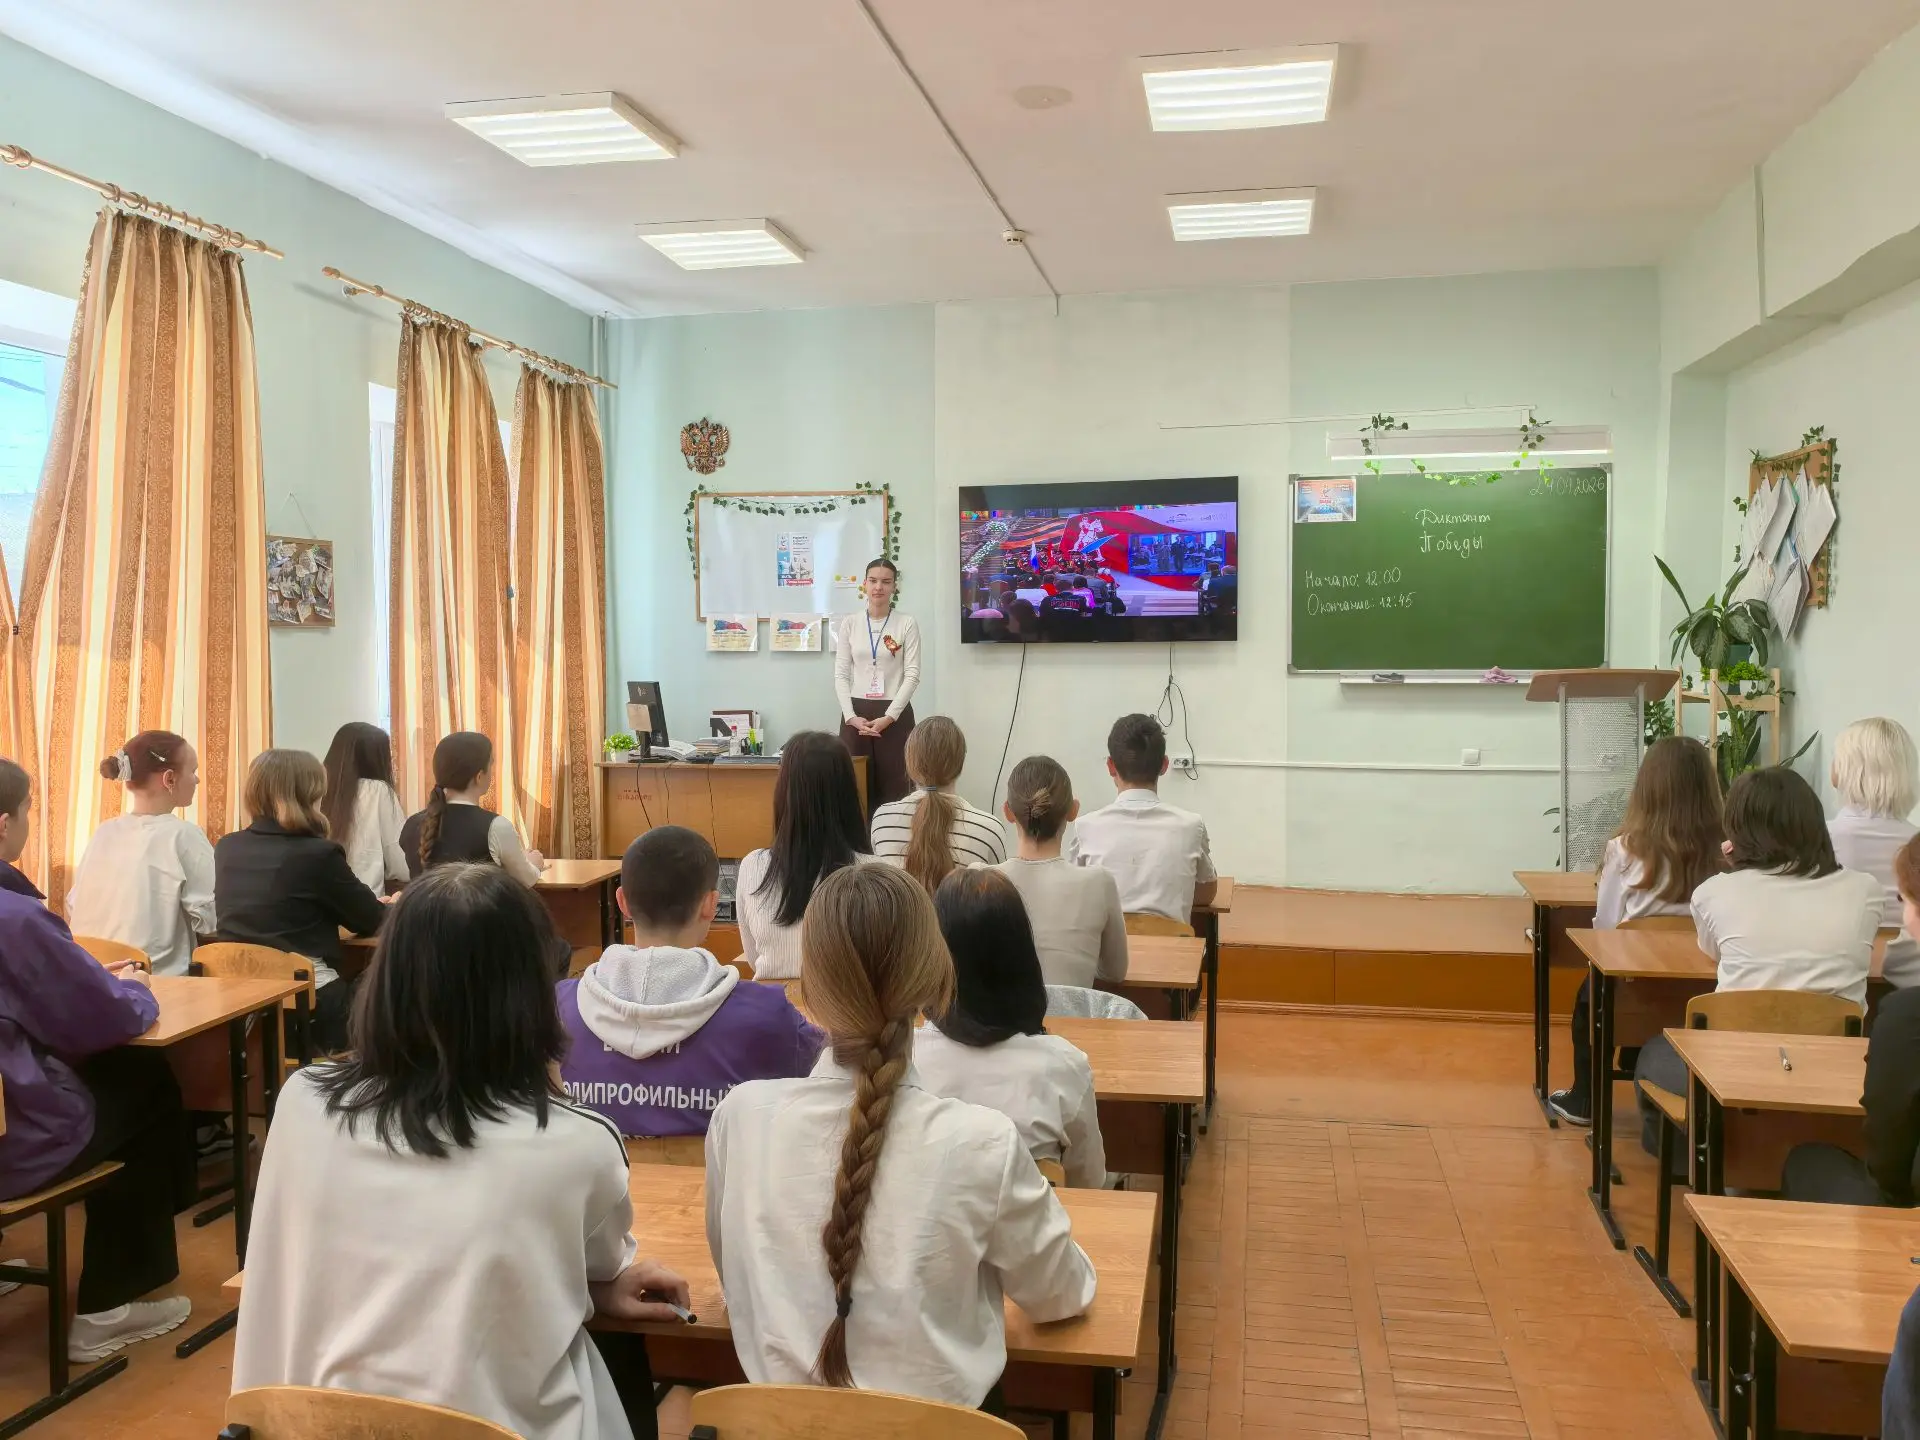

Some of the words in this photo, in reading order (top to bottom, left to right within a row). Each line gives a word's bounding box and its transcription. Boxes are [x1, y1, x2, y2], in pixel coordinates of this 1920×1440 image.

[1414, 508, 1491, 527] Диктант
[1419, 530, 1483, 559] Победы
[1307, 593, 1376, 616] Окончание:
[1379, 591, 1417, 609] 12:45
[563, 1081, 736, 1111] ОЛИПРОФИЛЬНЫ
